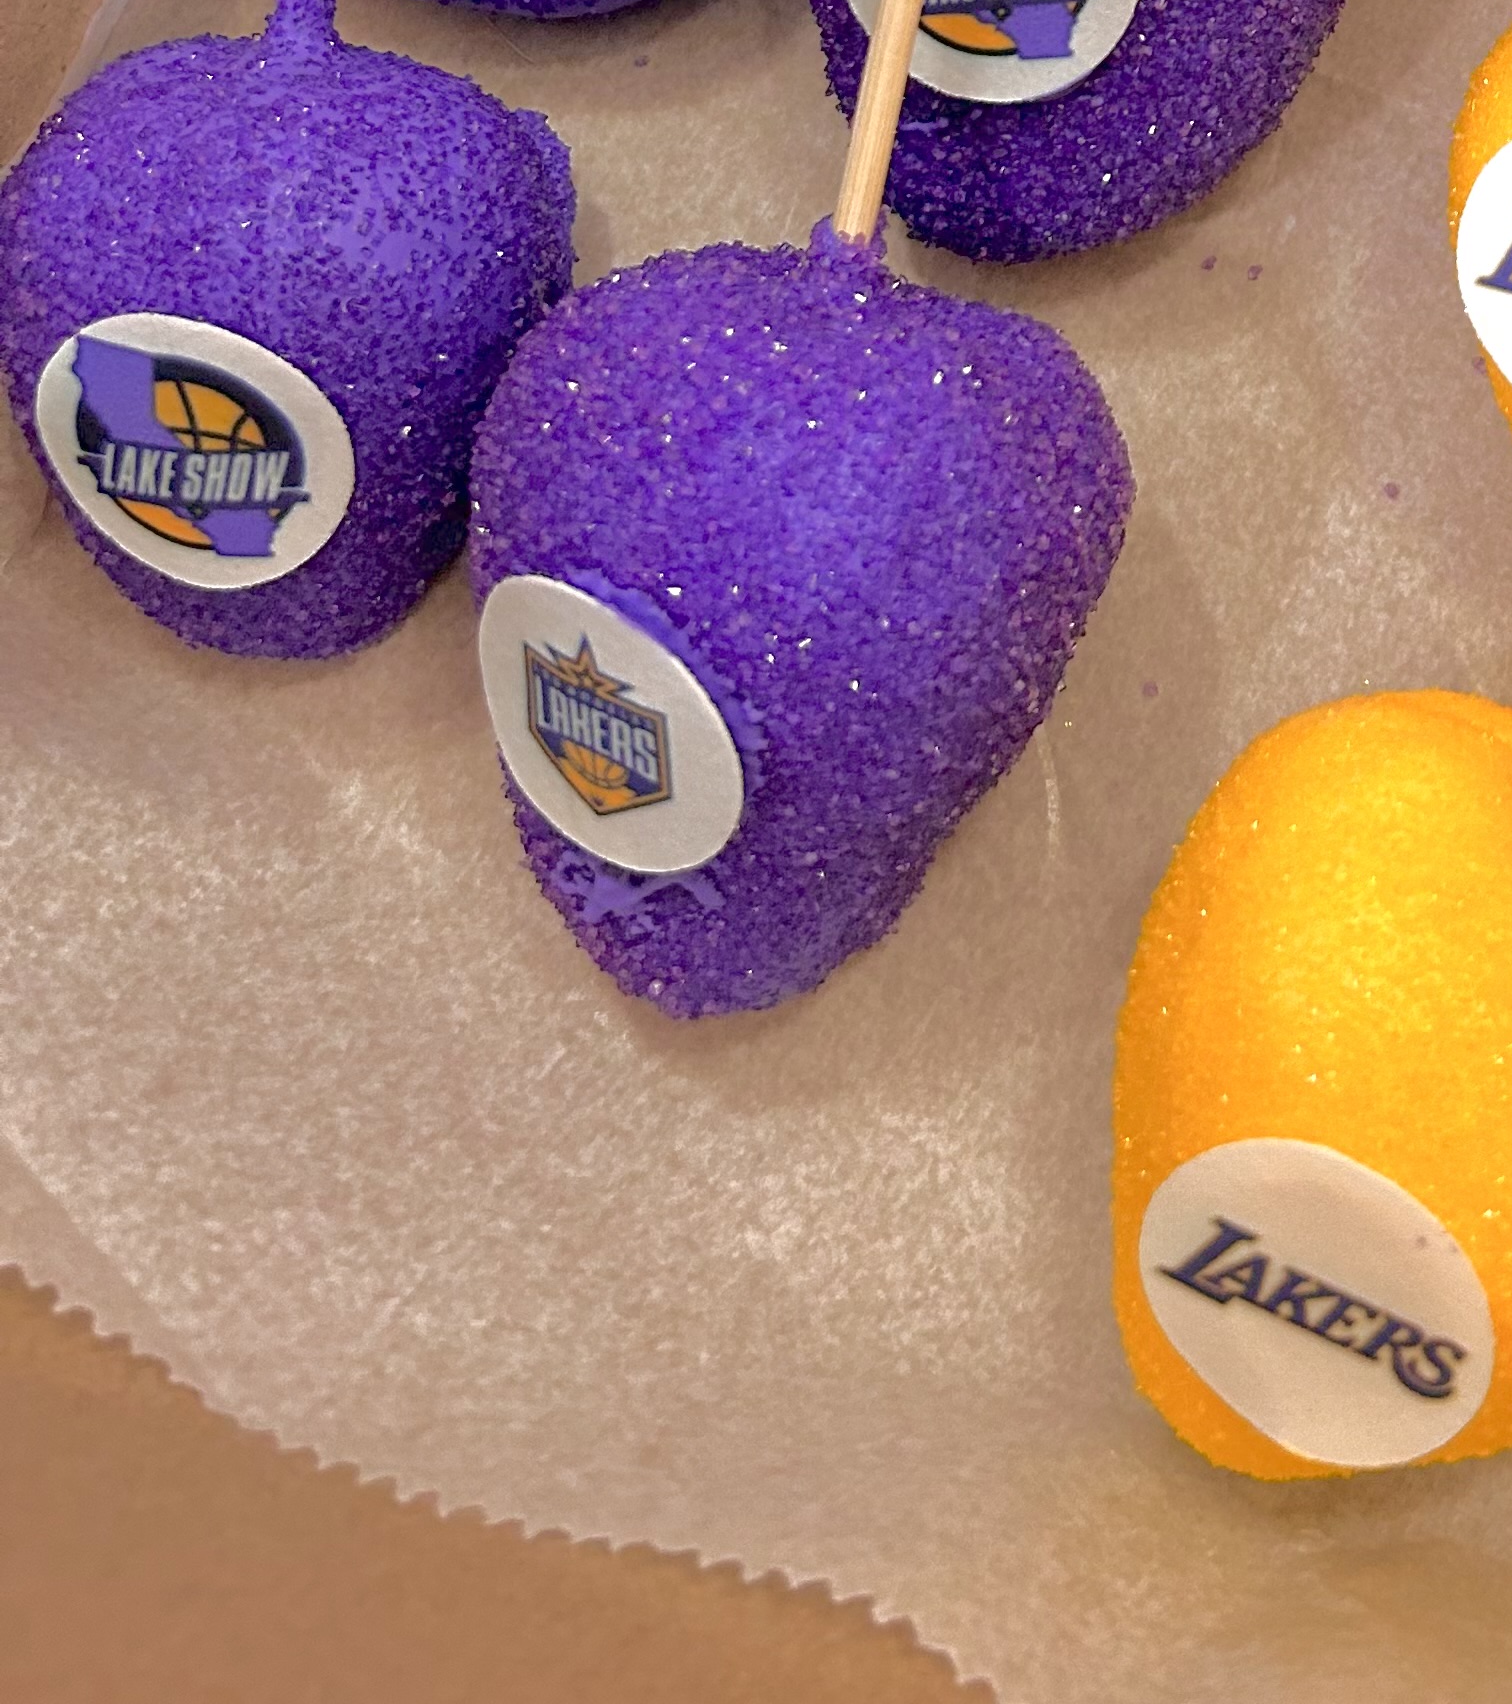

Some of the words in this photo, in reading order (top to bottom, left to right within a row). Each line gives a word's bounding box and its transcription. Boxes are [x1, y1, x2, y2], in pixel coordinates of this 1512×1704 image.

[102, 442, 178, 498] LAKE
[181, 449, 290, 503] SHOW
[536, 675, 660, 784] LAKERS
[1156, 1214, 1469, 1398] LAKERS
